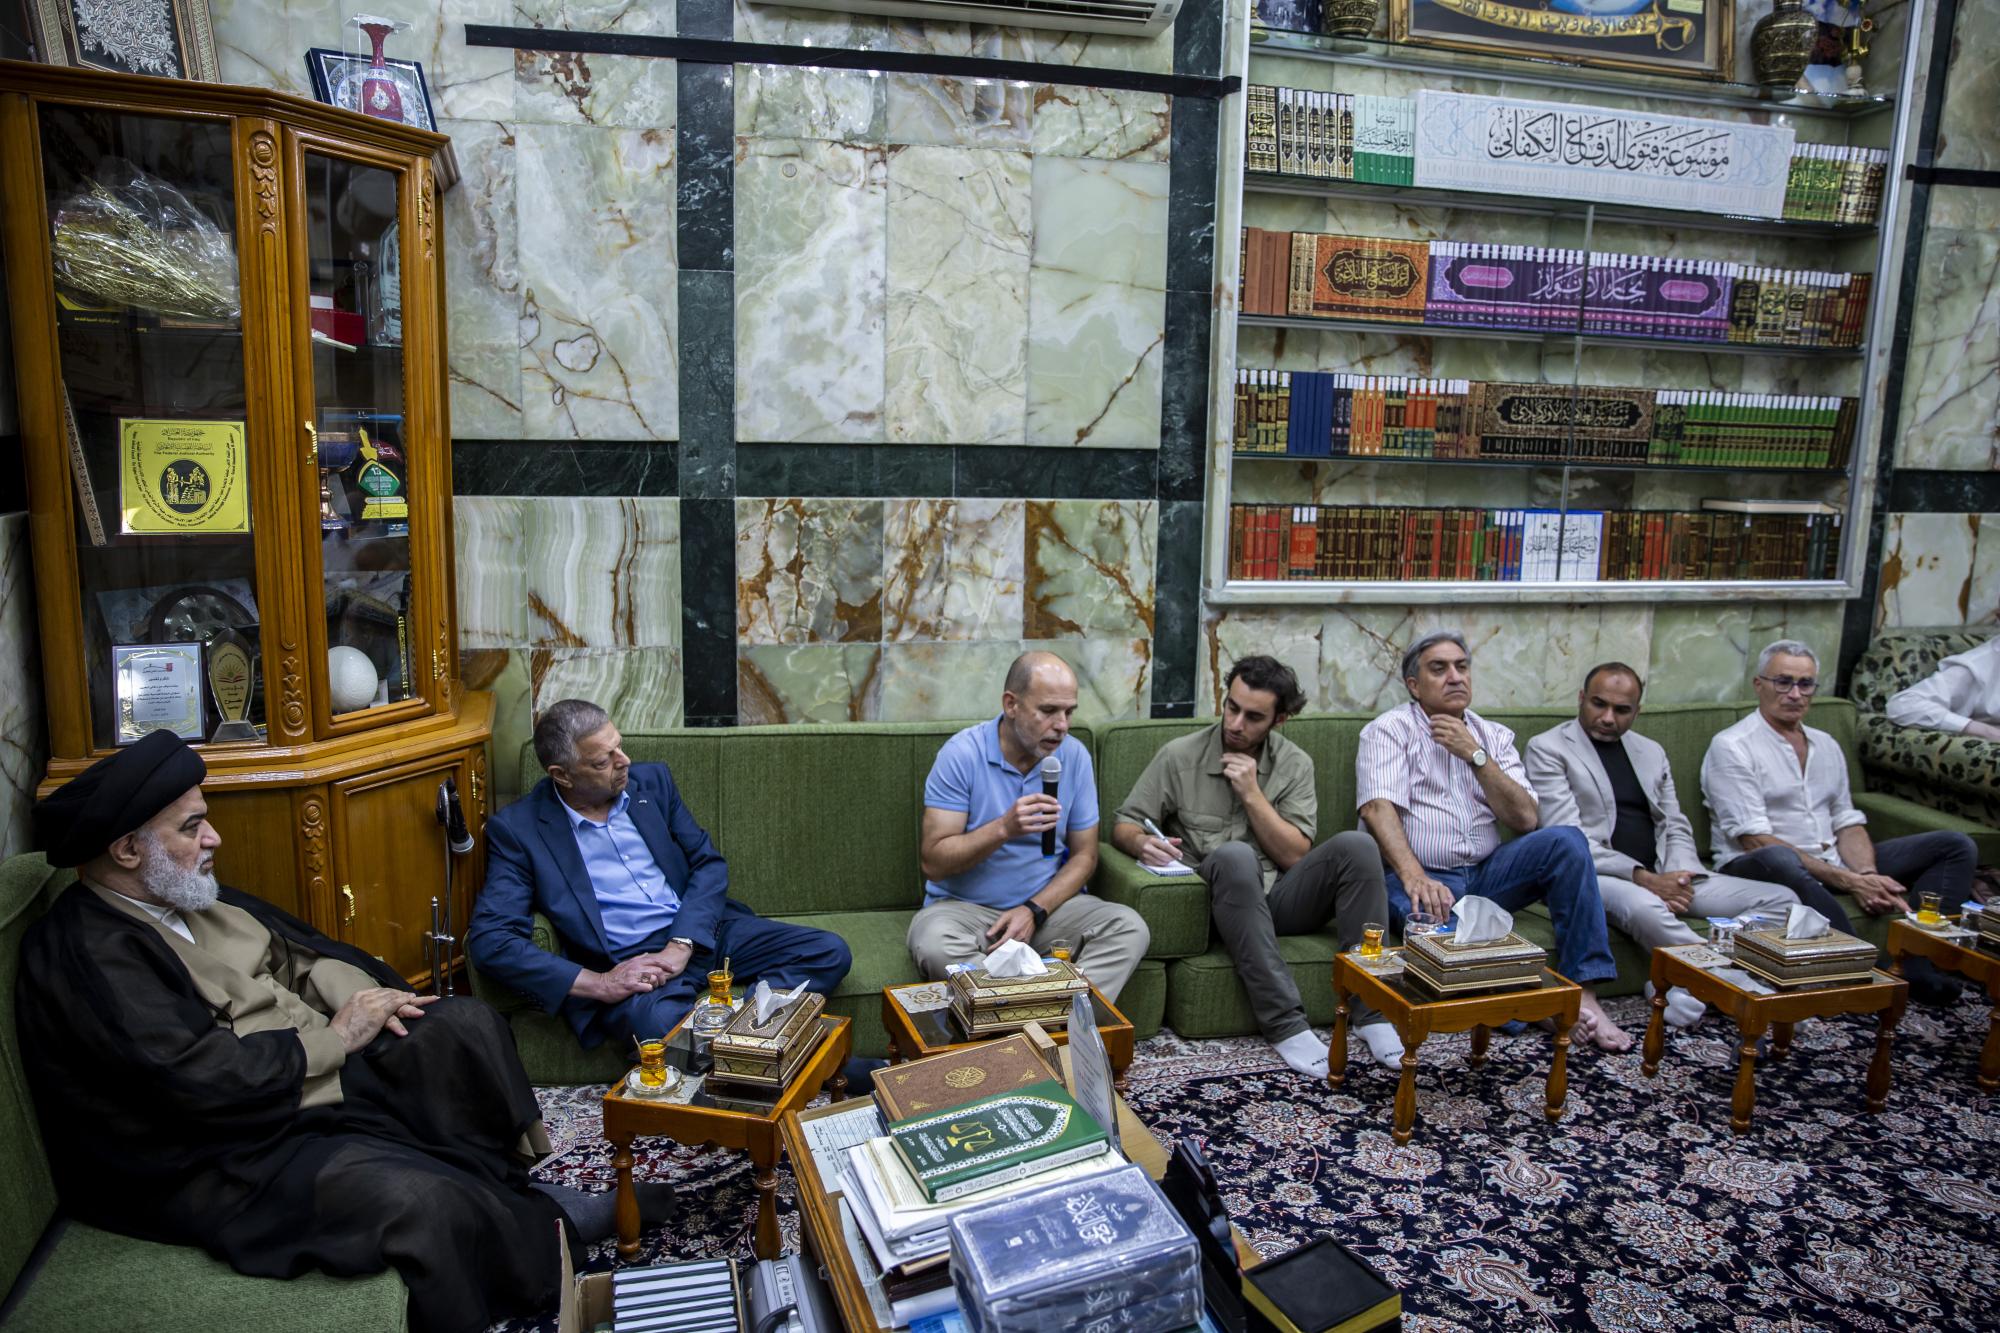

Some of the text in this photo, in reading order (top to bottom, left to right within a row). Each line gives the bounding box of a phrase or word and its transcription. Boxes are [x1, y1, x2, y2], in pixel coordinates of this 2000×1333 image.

[1564, 115, 1627, 170] الدفاع
[1625, 122, 1672, 172] فتوى
[1655, 127, 1731, 178] موسوعة
[1601, 268, 1647, 304] بحار
